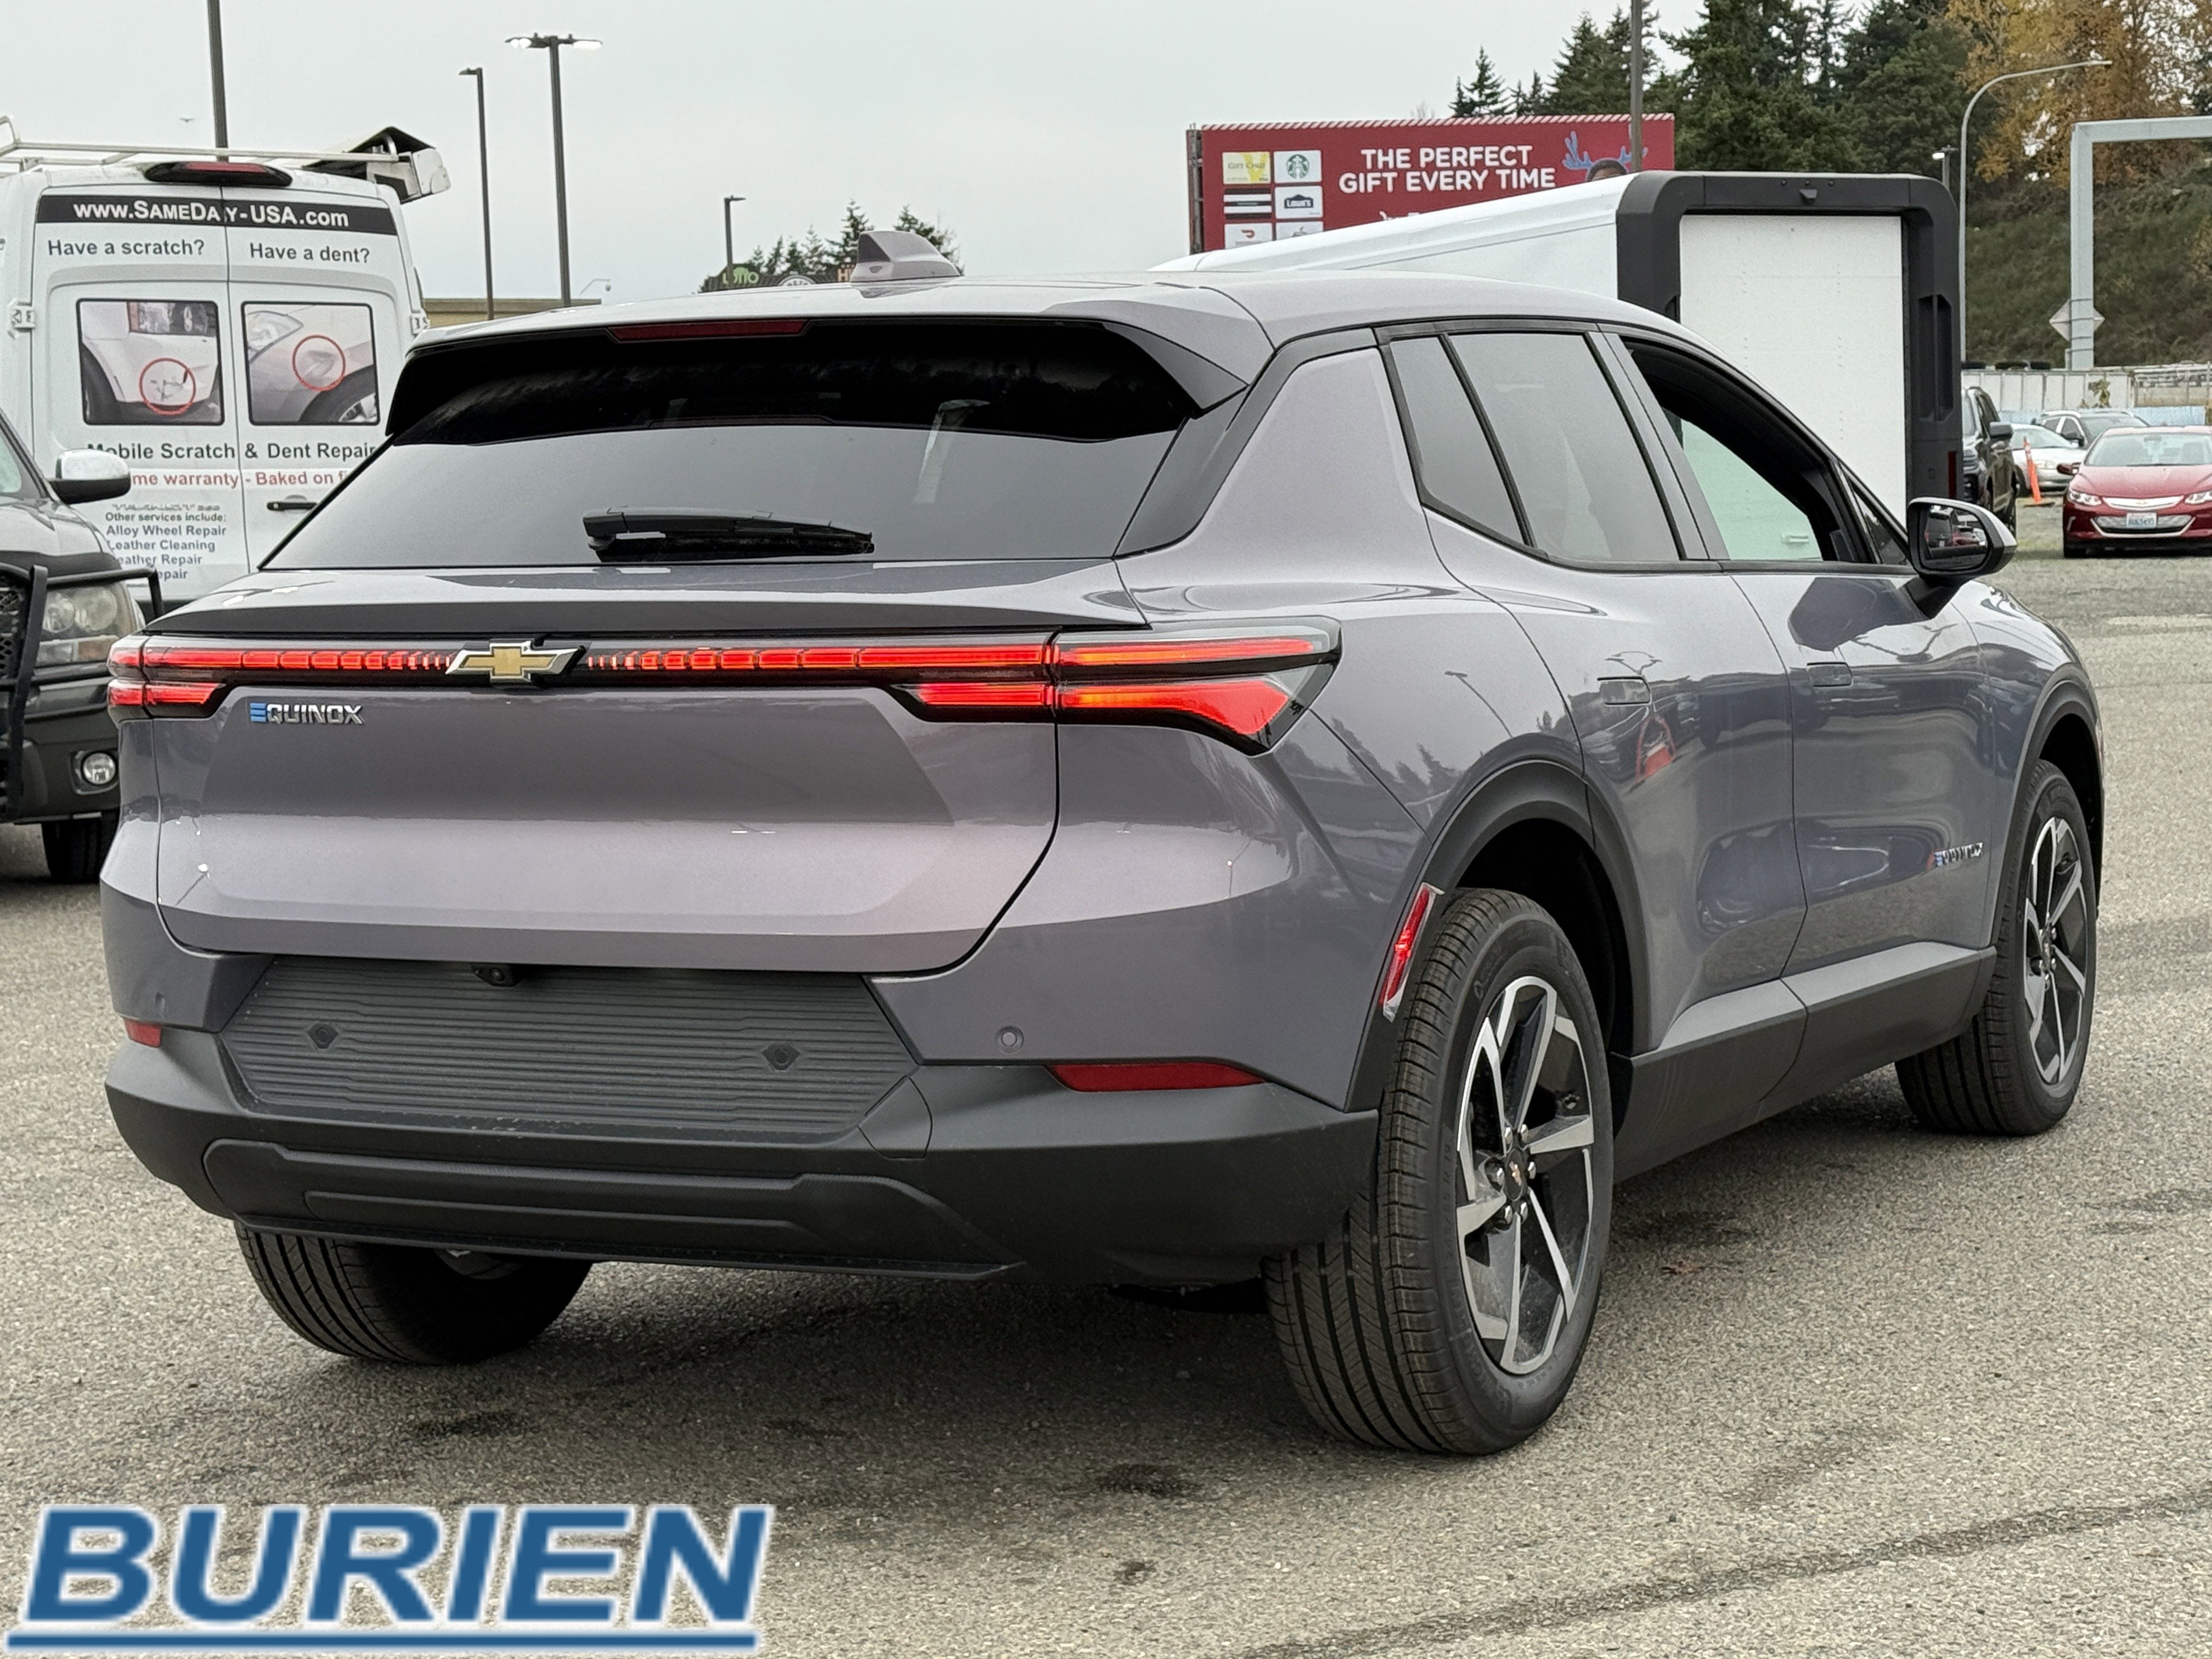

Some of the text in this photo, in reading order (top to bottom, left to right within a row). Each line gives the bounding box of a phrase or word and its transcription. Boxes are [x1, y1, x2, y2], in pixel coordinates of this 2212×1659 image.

[1361, 145, 1533, 170] THE PERFECT
[1339, 167, 1556, 194] GIFT EVERY TIME
[48, 239, 205, 256] Have a scratch?
[250, 242, 370, 263] Have a dent?
[161, 443, 235, 459] Scratch
[245, 443, 258, 459] &
[268, 443, 311, 459] Dent
[318, 442, 376, 462] Repair
[164, 472, 239, 489] warranty
[256, 471, 308, 486] Baked
[313, 473, 334, 484] on
[105, 512, 136, 521] Other
[139, 512, 182, 522] services
[106, 524, 227, 538] Alloy Wheel Repair
[160, 539, 216, 553] Cleaning
[119, 554, 203, 567] eather Repair
[250, 702, 365, 725] EQUINOX
